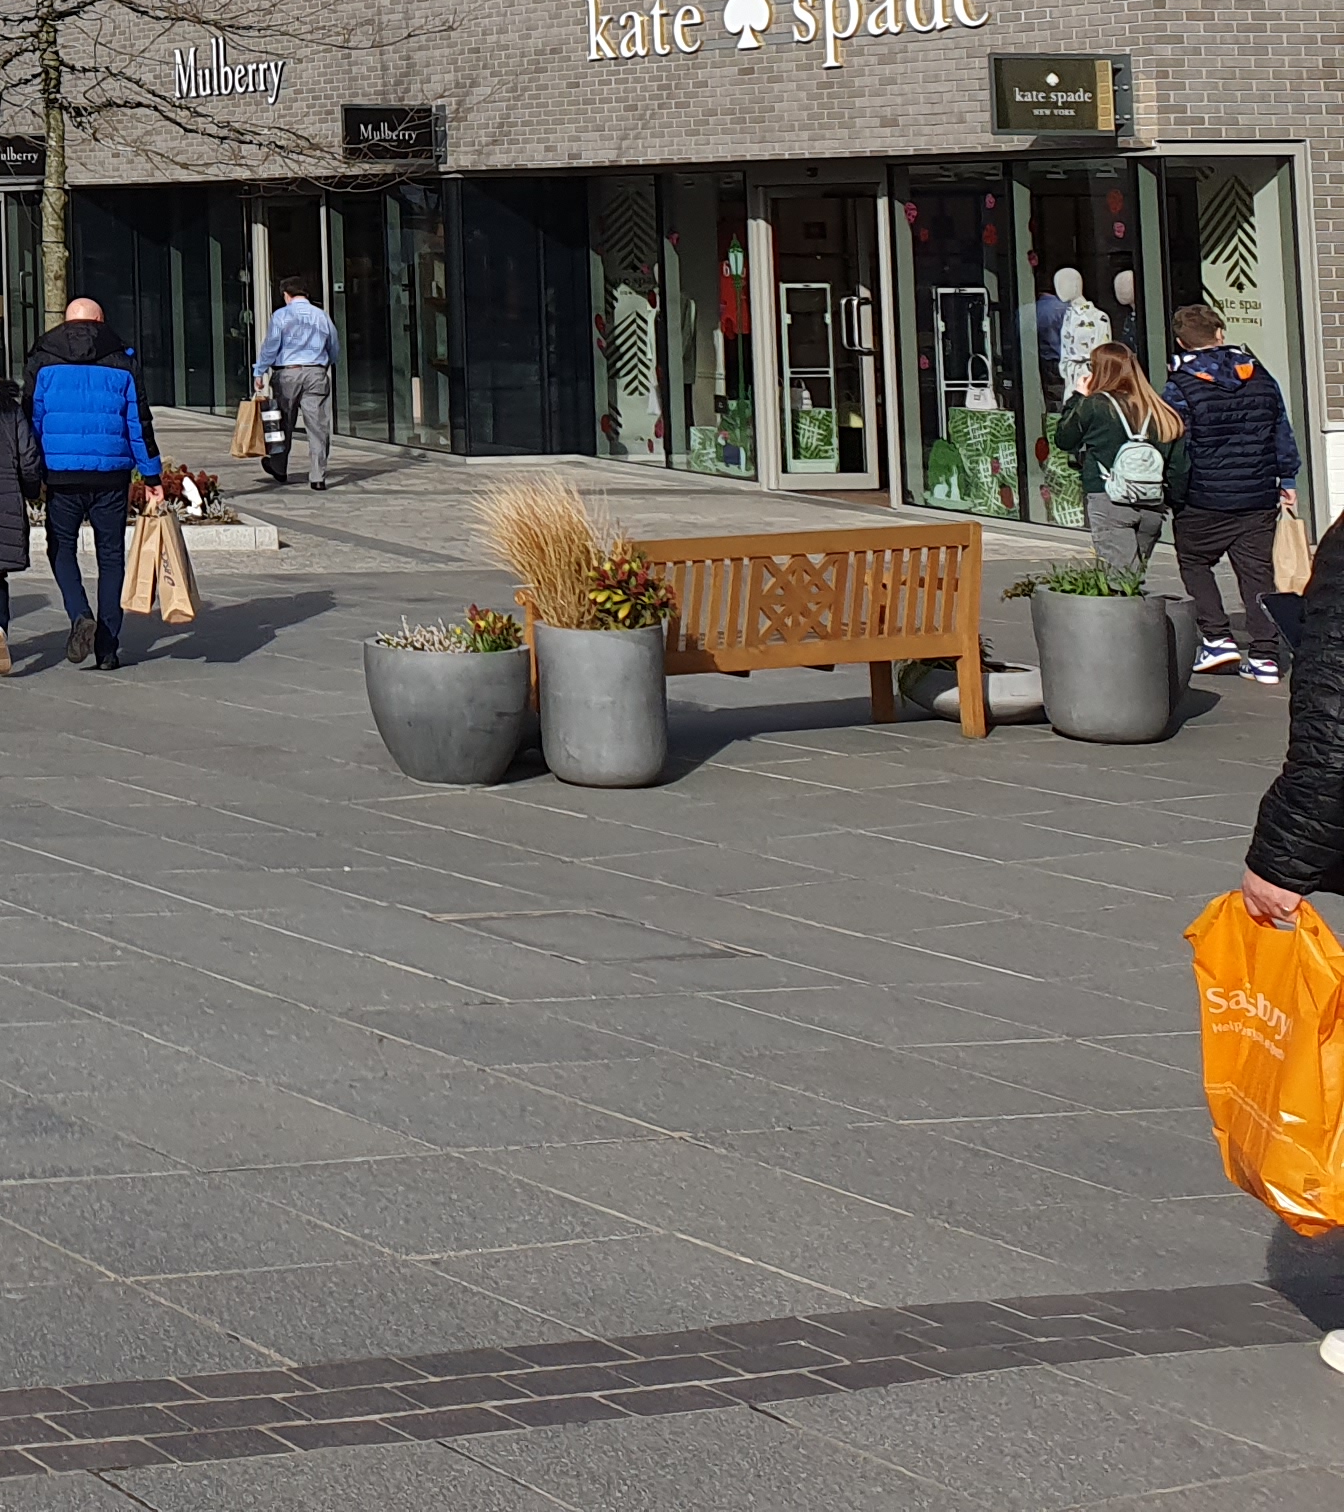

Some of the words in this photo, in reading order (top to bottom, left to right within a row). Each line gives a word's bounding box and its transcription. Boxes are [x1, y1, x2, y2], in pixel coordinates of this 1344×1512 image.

[174, 36, 287, 105] Mulberry
[1014, 87, 1047, 102] kate
[1050, 88, 1092, 106] spade
[359, 122, 417, 144] Mulberry
